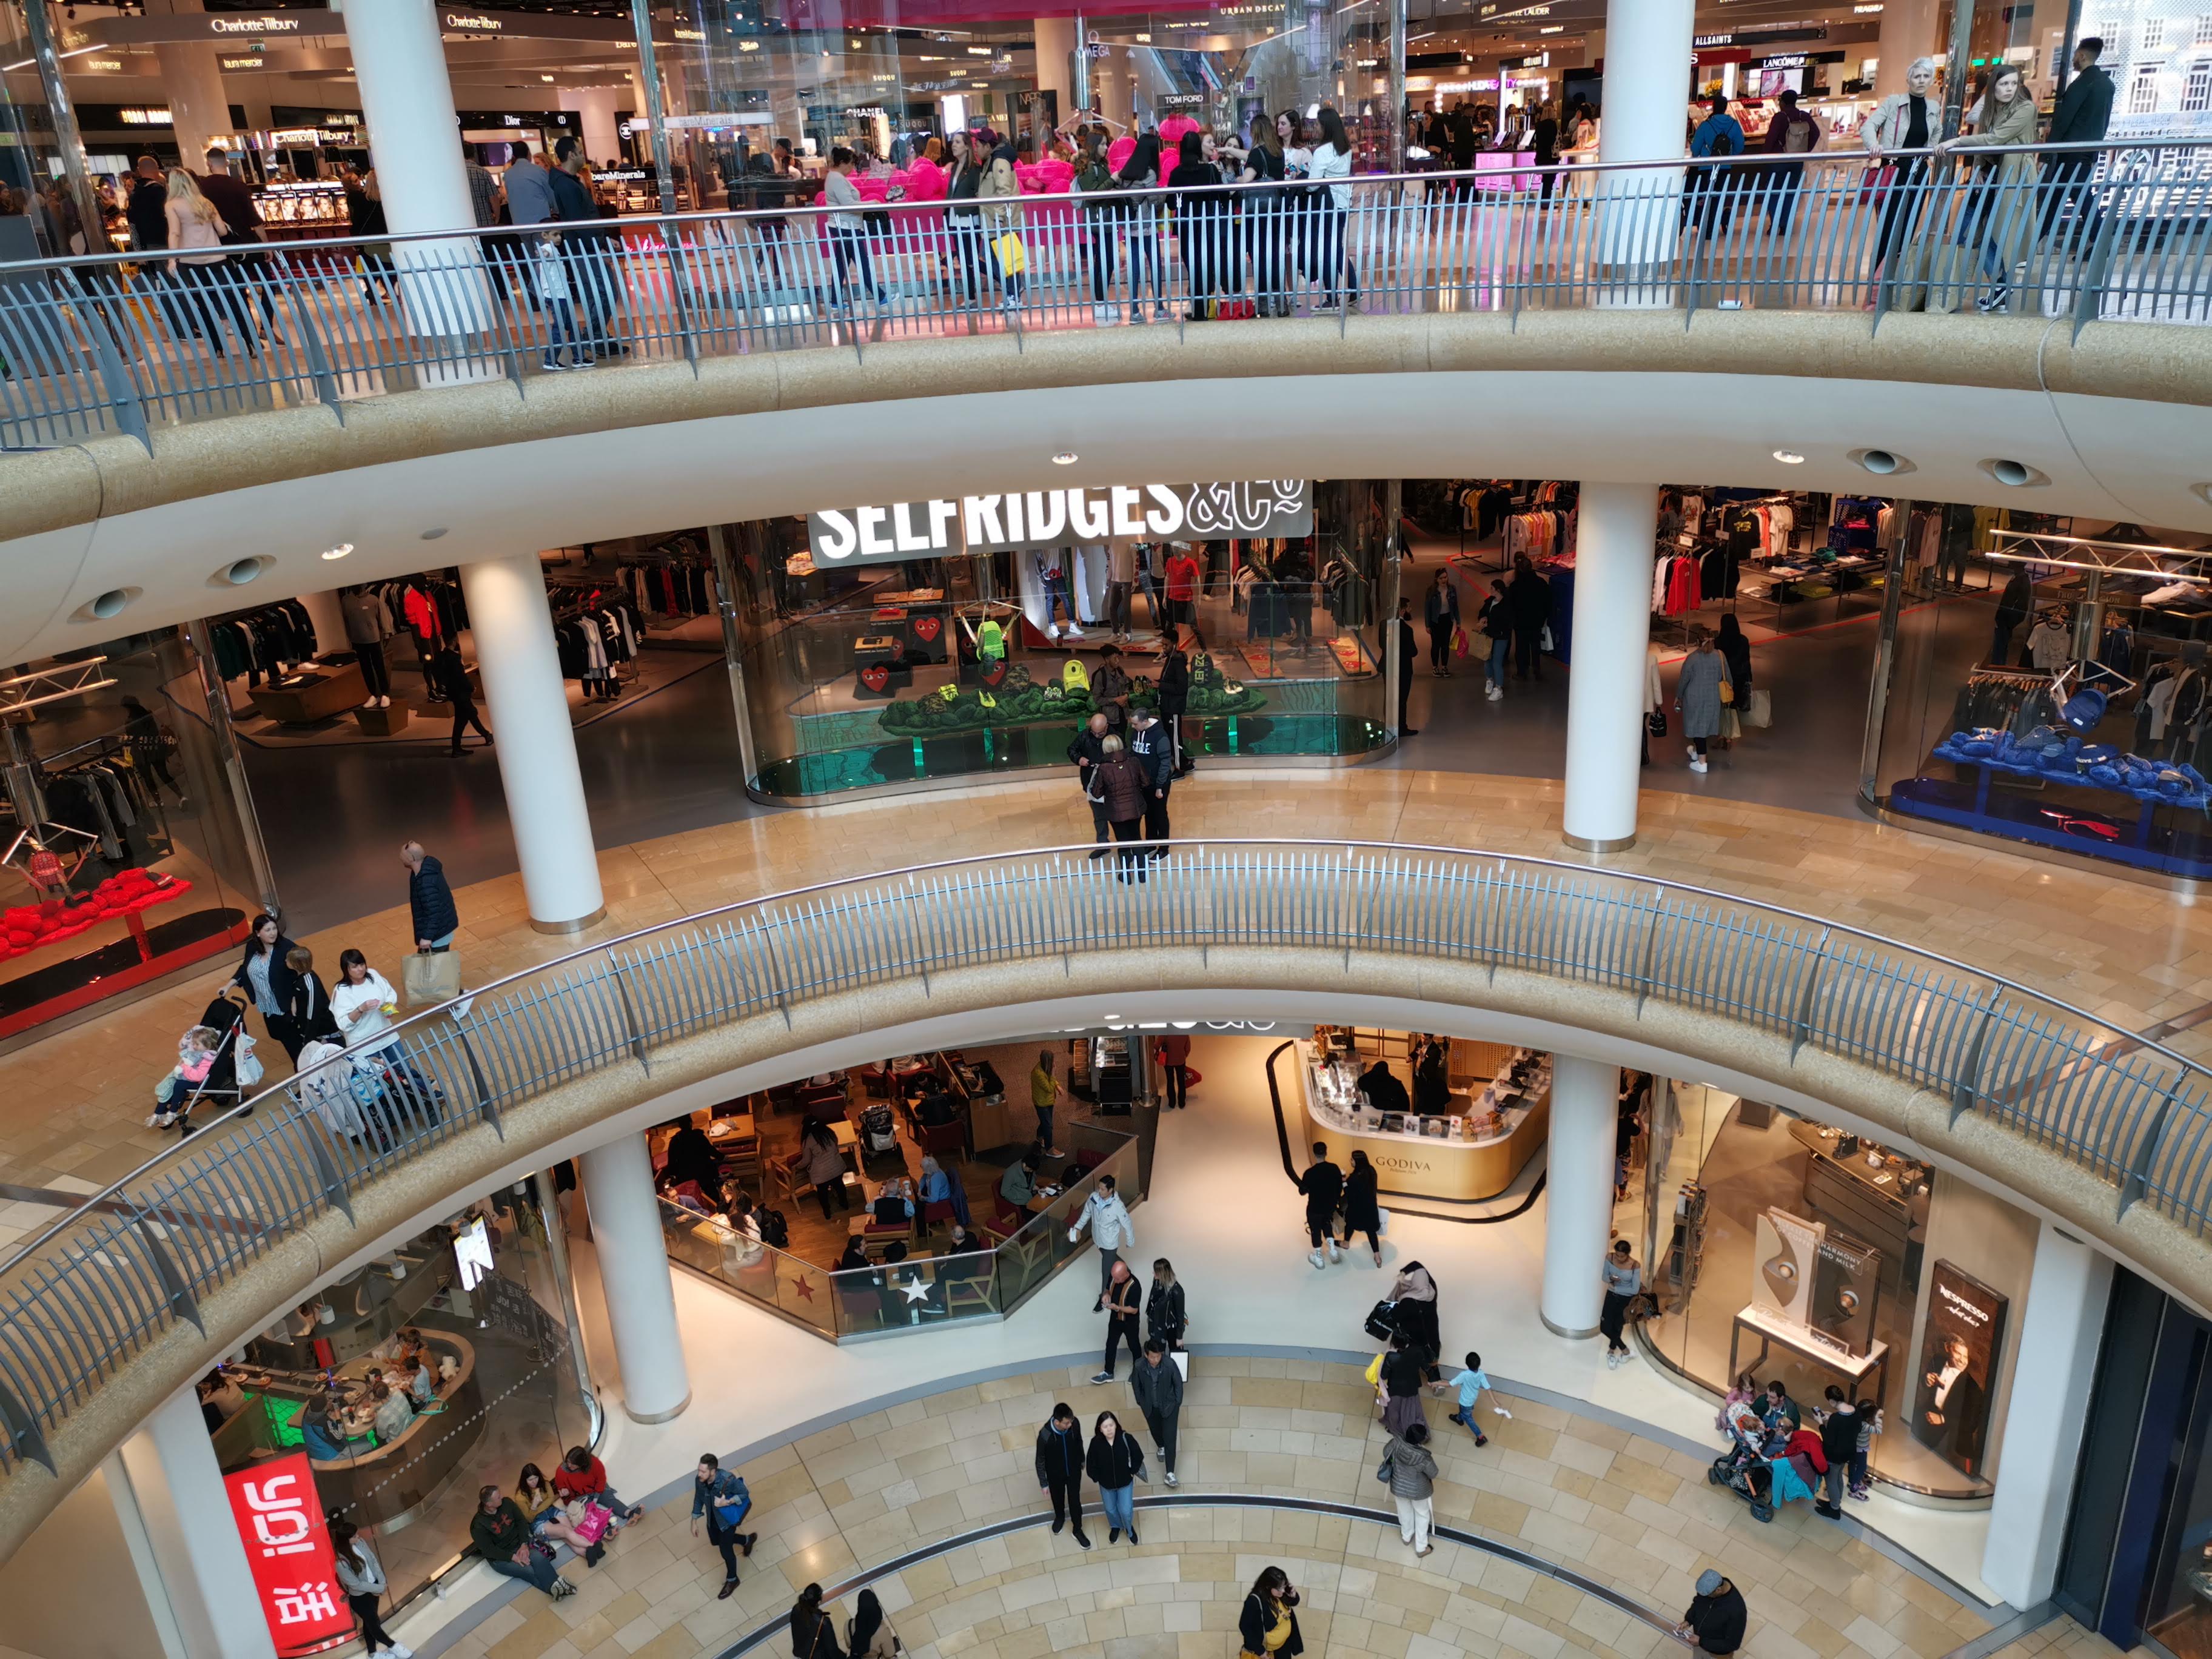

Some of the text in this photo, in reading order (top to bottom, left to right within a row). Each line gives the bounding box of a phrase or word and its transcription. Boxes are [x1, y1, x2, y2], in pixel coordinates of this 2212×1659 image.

[1220, 4, 1285, 16] URBAN DECAY
[1695, 35, 1732, 46] ALLSAINTS
[1763, 57, 1798, 69] LANCÔME
[1182, 95, 1204, 103] FORD
[846, 107, 887, 118] CHANEL
[504, 115, 520, 127] Dior
[679, 115, 734, 128] bareMinerals
[591, 170, 646, 181] bareMinerals
[817, 484, 1183, 560] SELFRIDGES
[1375, 1156, 1431, 1171] GODIVA
[1817, 1248, 1834, 1260] AND
[1835, 1256, 1855, 1271] MILK
[1820, 1242, 1862, 1265] HARMONY
[1939, 1283, 1989, 1322] NESPRESSO
[273, 1581, 337, 1624] 活
